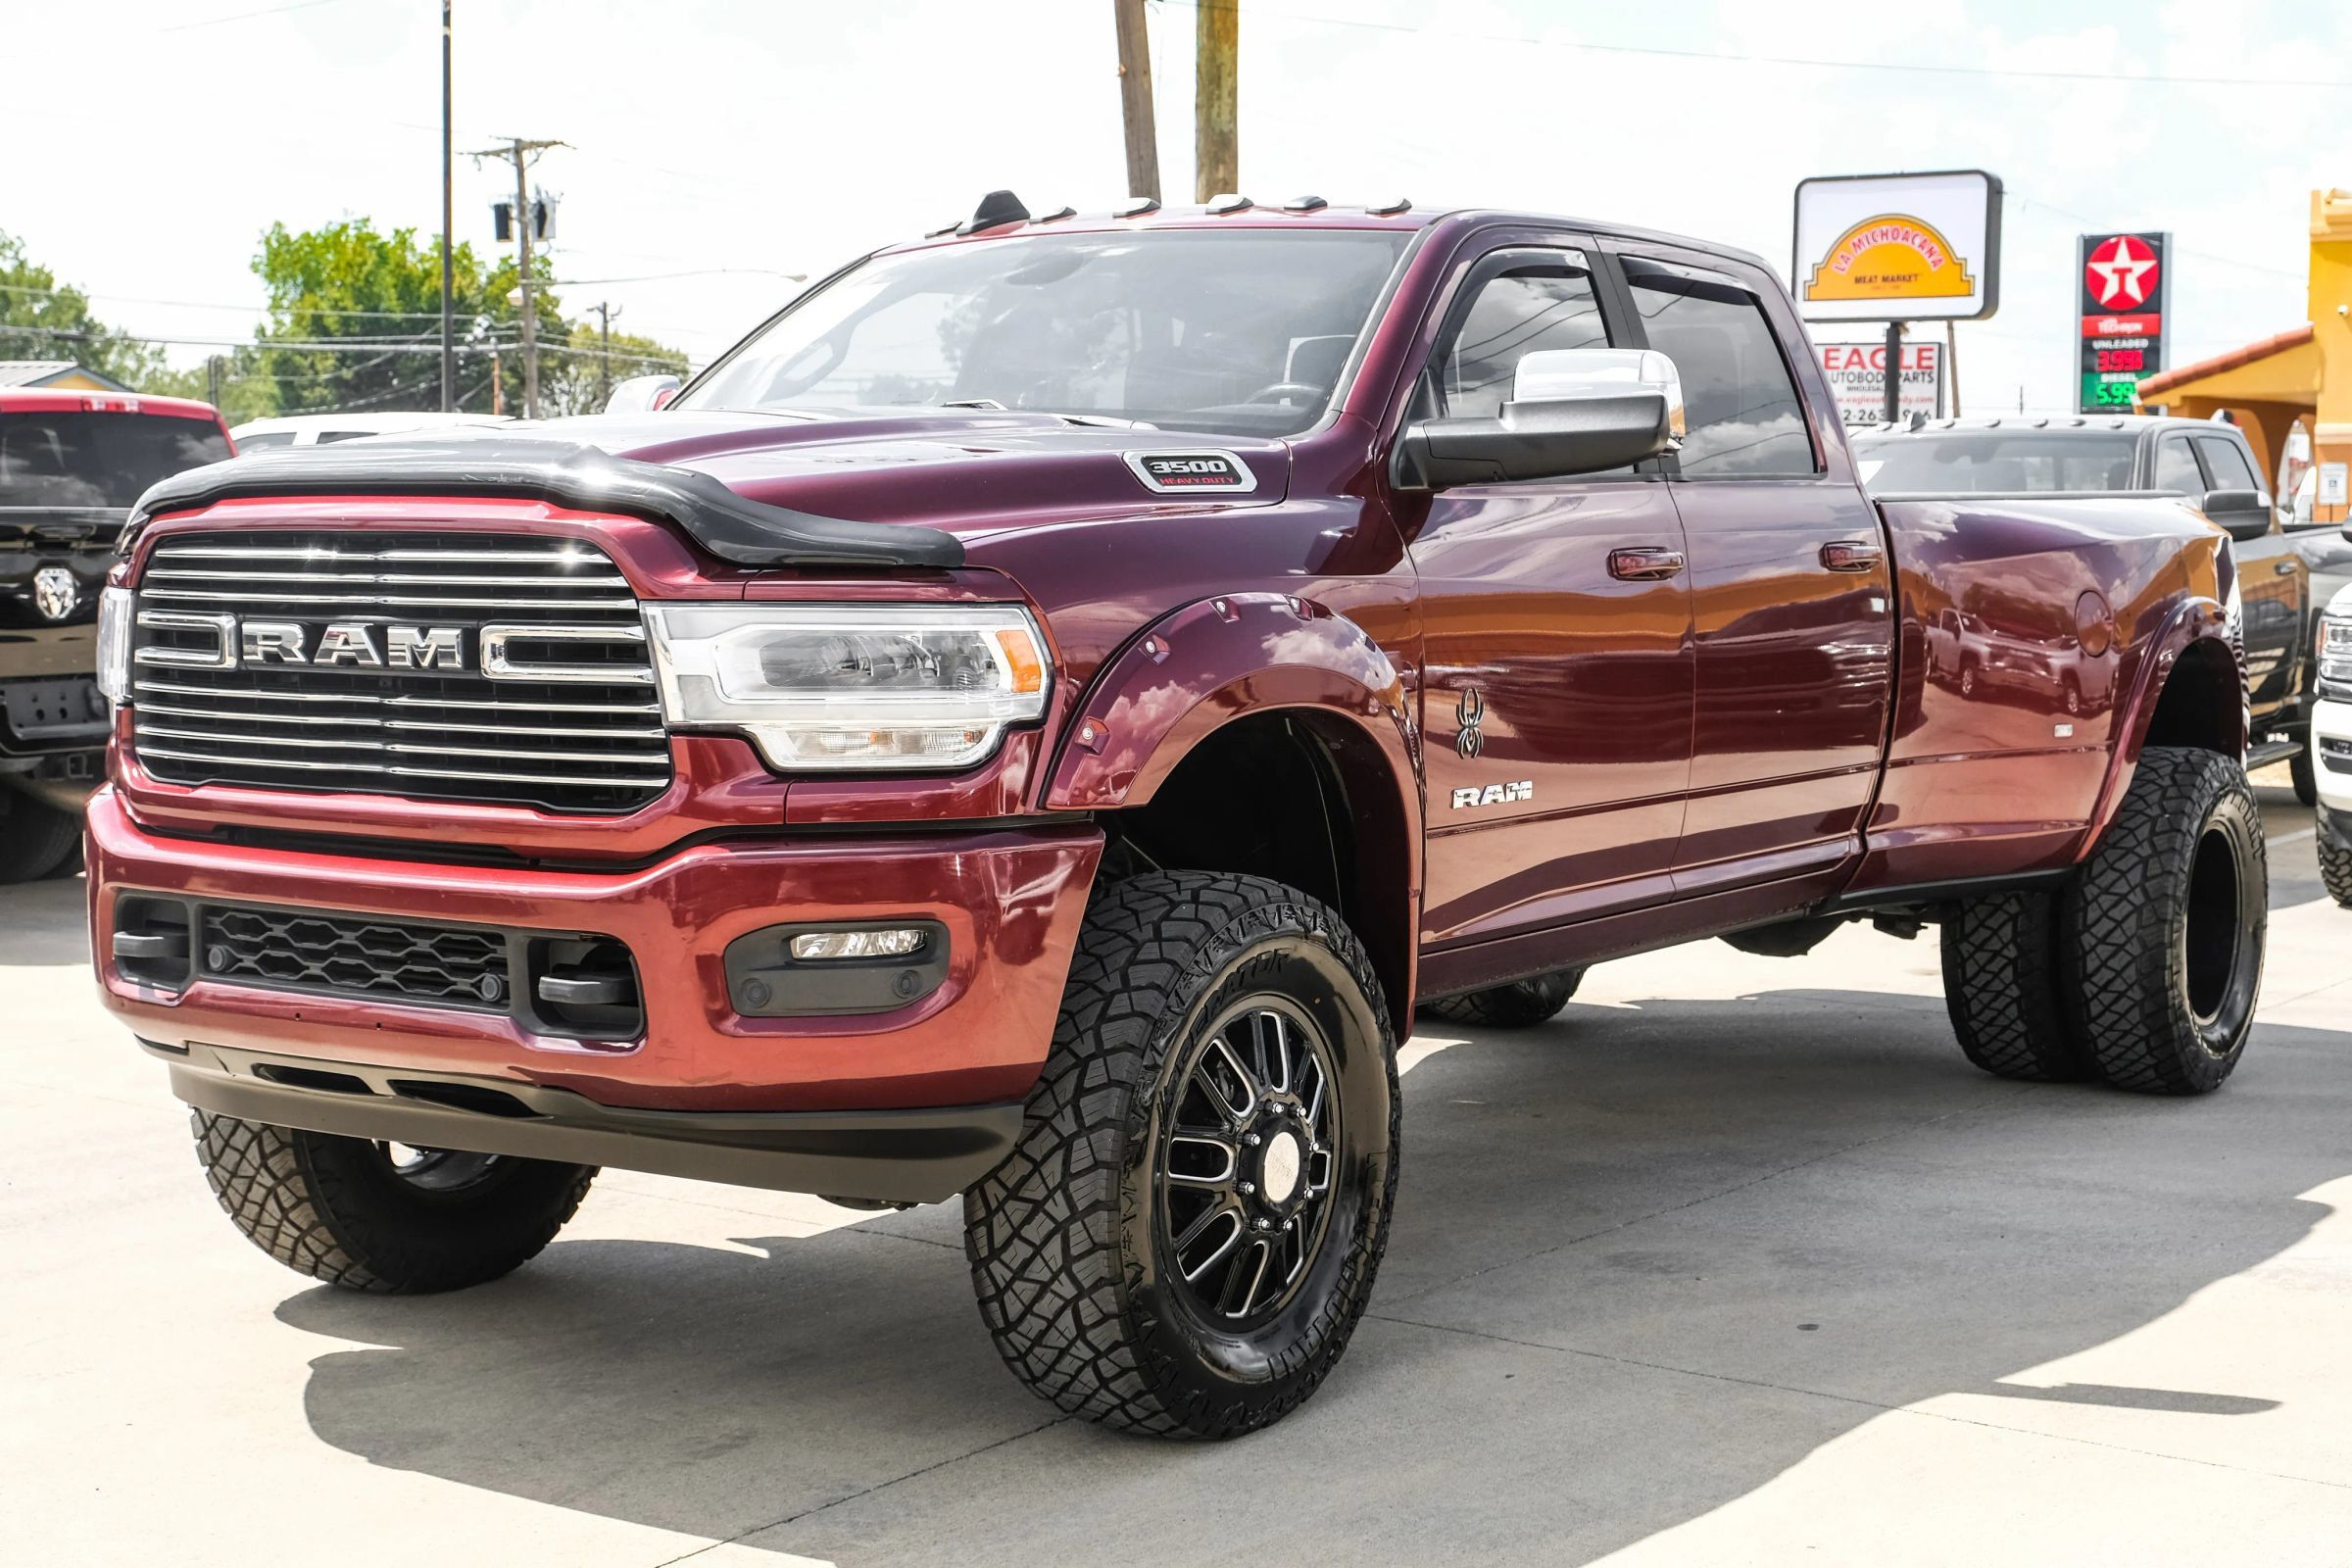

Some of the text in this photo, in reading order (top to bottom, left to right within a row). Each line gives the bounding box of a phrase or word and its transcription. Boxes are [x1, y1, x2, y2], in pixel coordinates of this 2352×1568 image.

[1833, 226, 1944, 273] LA MICHOACANA
[1854, 273, 1919, 284] MEAT MARKET
[2092, 339, 2149, 350] UNLEADED
[1824, 347, 1935, 369] EAGLE
[1831, 371, 1886, 384] UTOBOD
[2100, 372, 2137, 383] DIESEL
[1150, 461, 1228, 473] 3500
[241, 621, 465, 669] RAM
[1450, 780, 1533, 809] RAM
